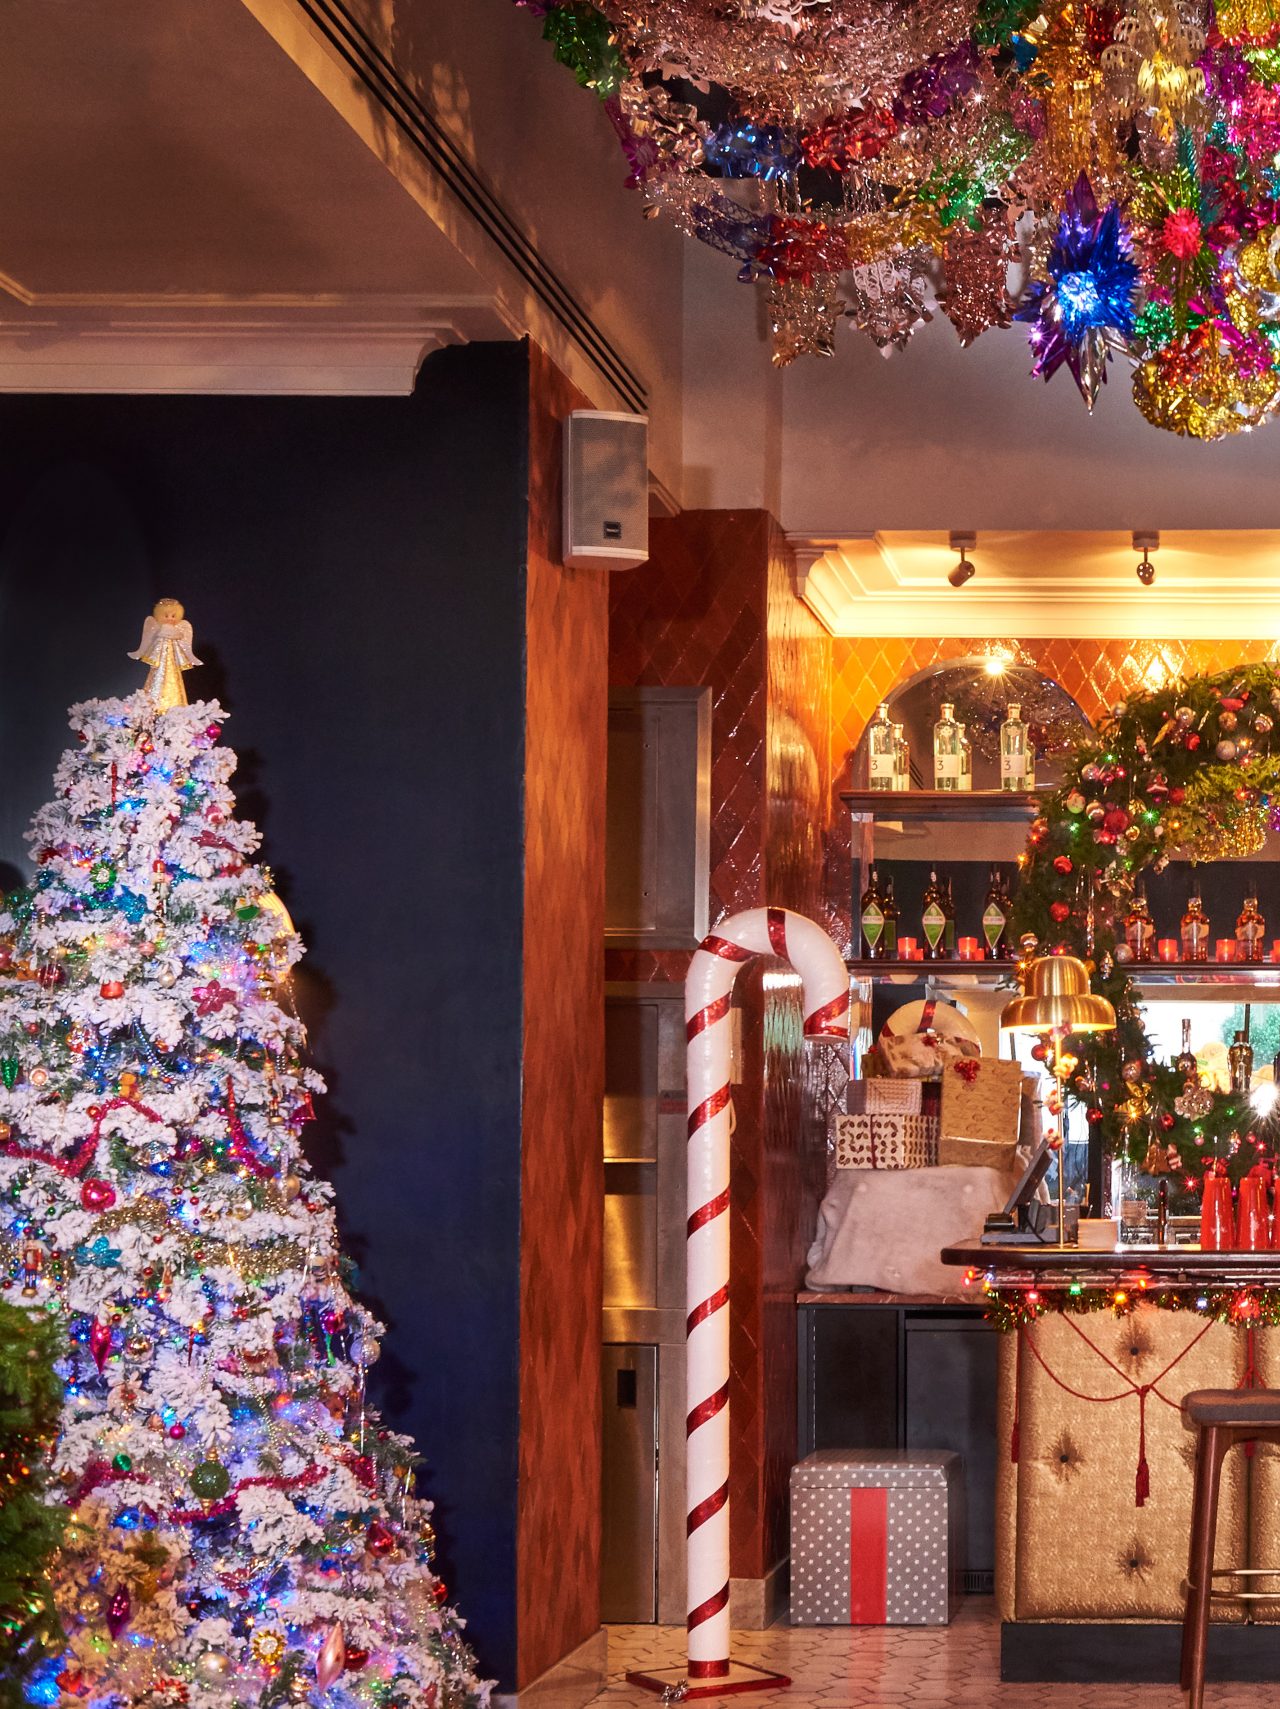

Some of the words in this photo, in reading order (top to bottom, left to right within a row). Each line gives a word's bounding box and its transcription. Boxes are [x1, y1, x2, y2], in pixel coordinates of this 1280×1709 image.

[871, 760, 878, 771] 3
[937, 760, 944, 771] 3
[1004, 760, 1011, 771] 3
